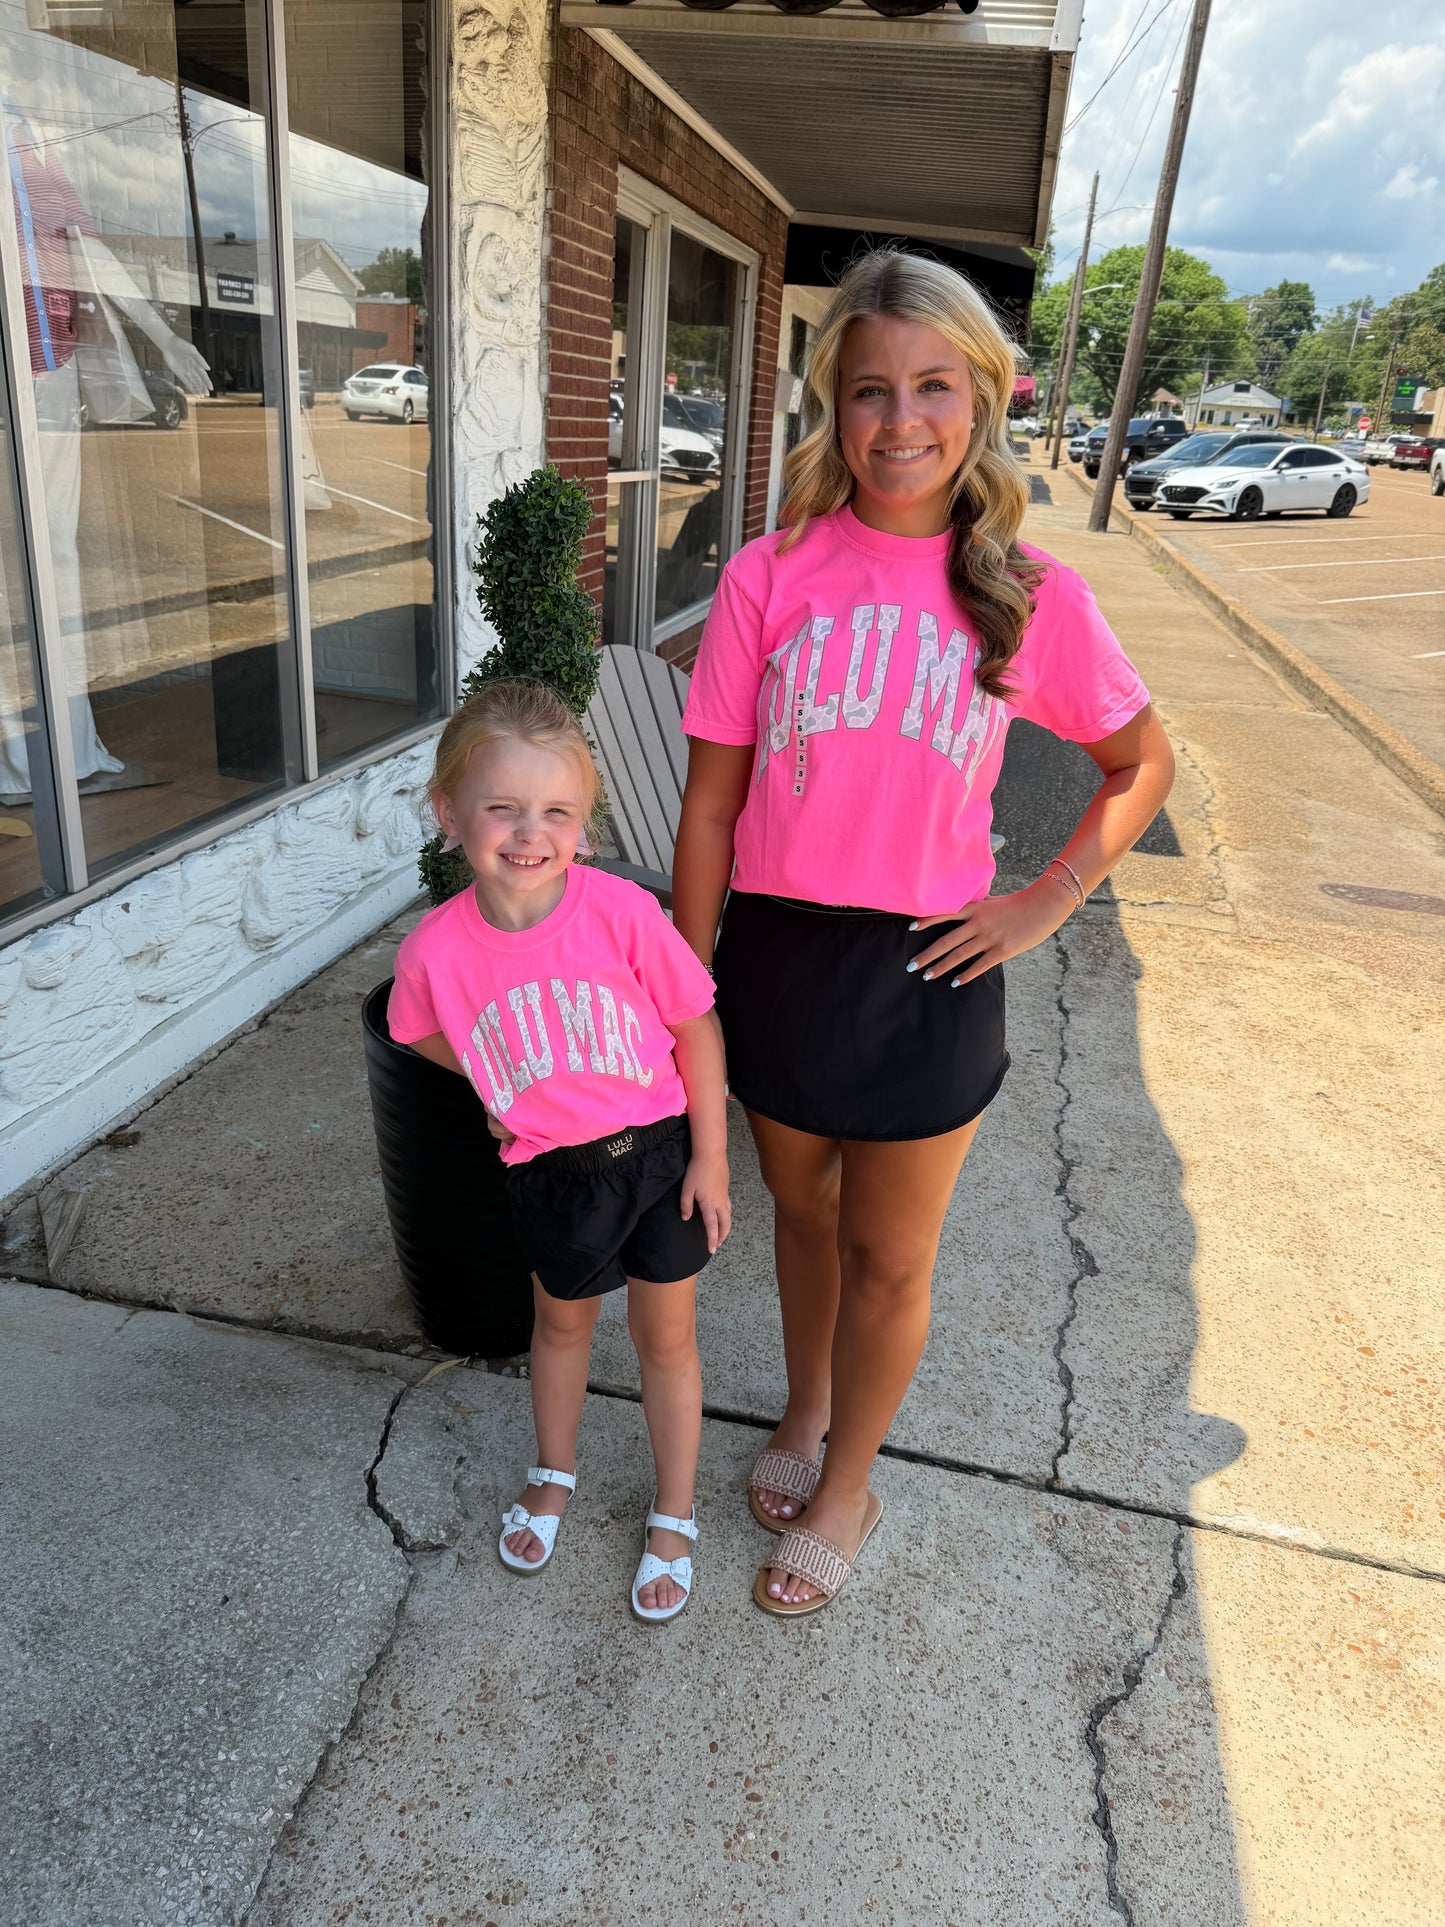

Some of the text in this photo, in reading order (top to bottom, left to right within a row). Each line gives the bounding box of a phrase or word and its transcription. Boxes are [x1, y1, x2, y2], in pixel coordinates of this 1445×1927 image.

[550, 978, 654, 1089] MAC
[607, 1134, 633, 1151] LULU
[611, 1143, 633, 1158] MAC
